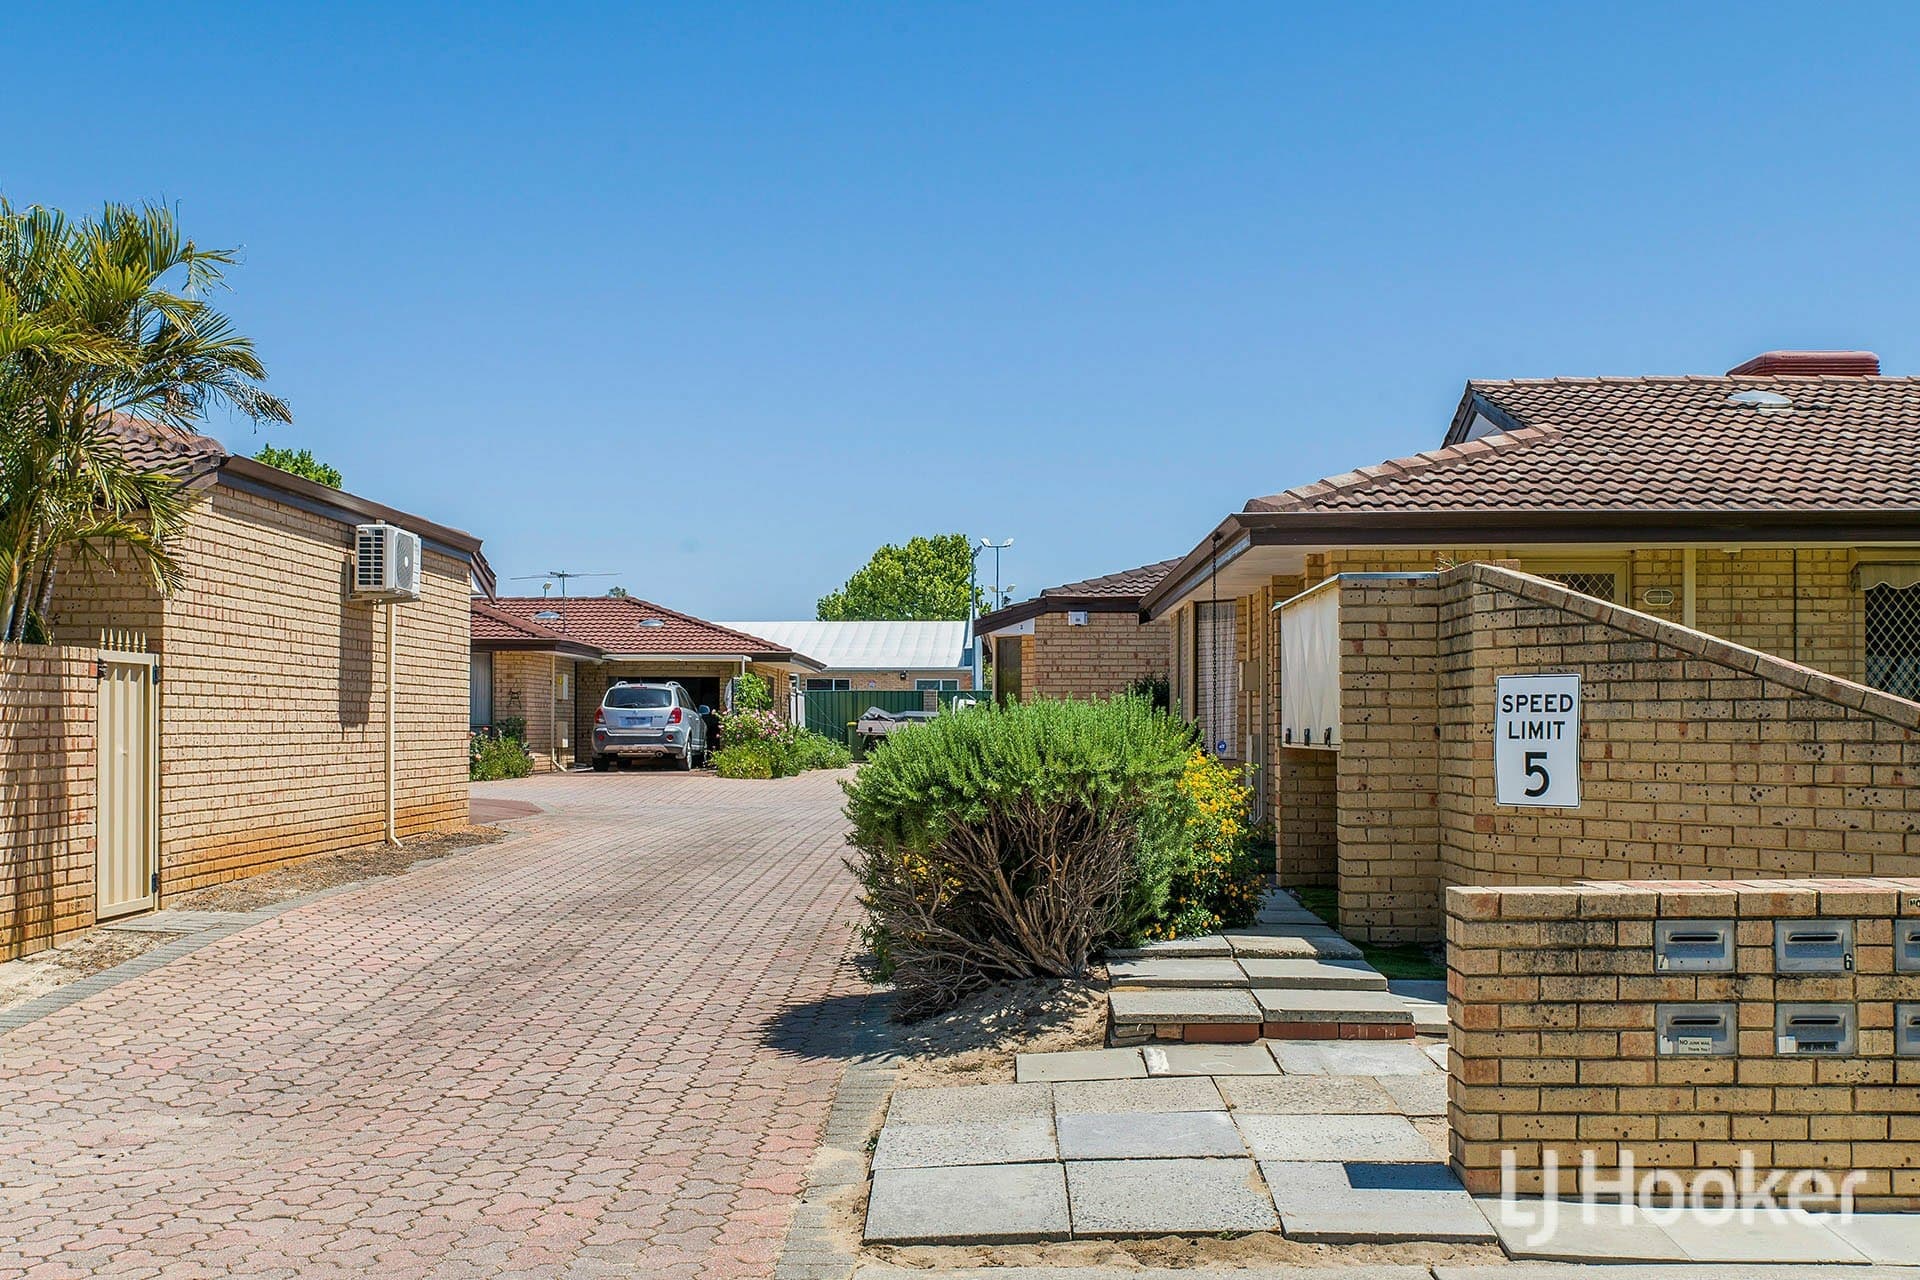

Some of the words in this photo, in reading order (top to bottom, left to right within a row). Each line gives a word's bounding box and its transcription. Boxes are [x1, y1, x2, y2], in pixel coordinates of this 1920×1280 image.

[1502, 693, 1574, 713] SPEED
[1508, 720, 1565, 740] LIMIT
[1524, 751, 1550, 797] 5
